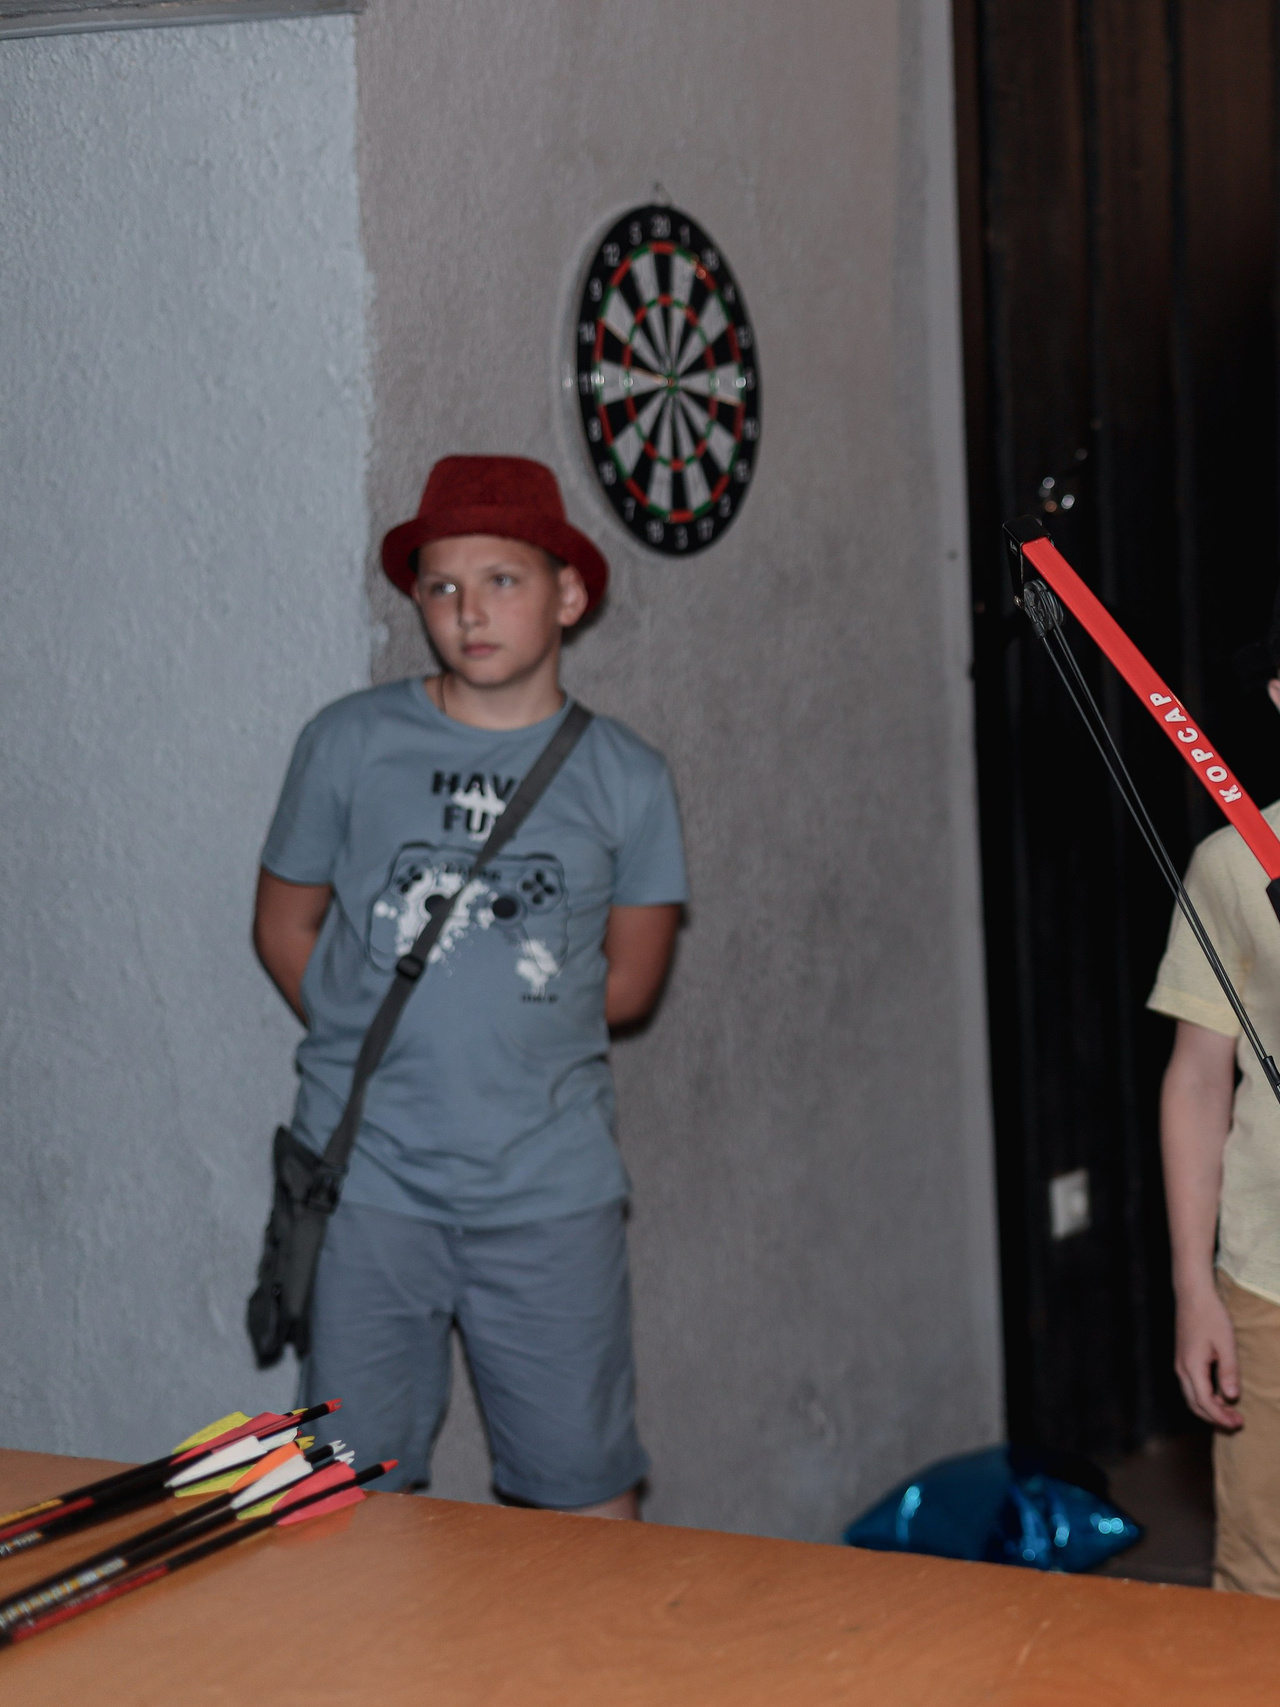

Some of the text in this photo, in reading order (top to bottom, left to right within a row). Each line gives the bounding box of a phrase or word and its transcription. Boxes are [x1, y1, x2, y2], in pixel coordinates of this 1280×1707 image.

[1149, 692, 1242, 803] КОРСАР
[432, 770, 516, 801] HAV
[443, 804, 492, 834] FU
